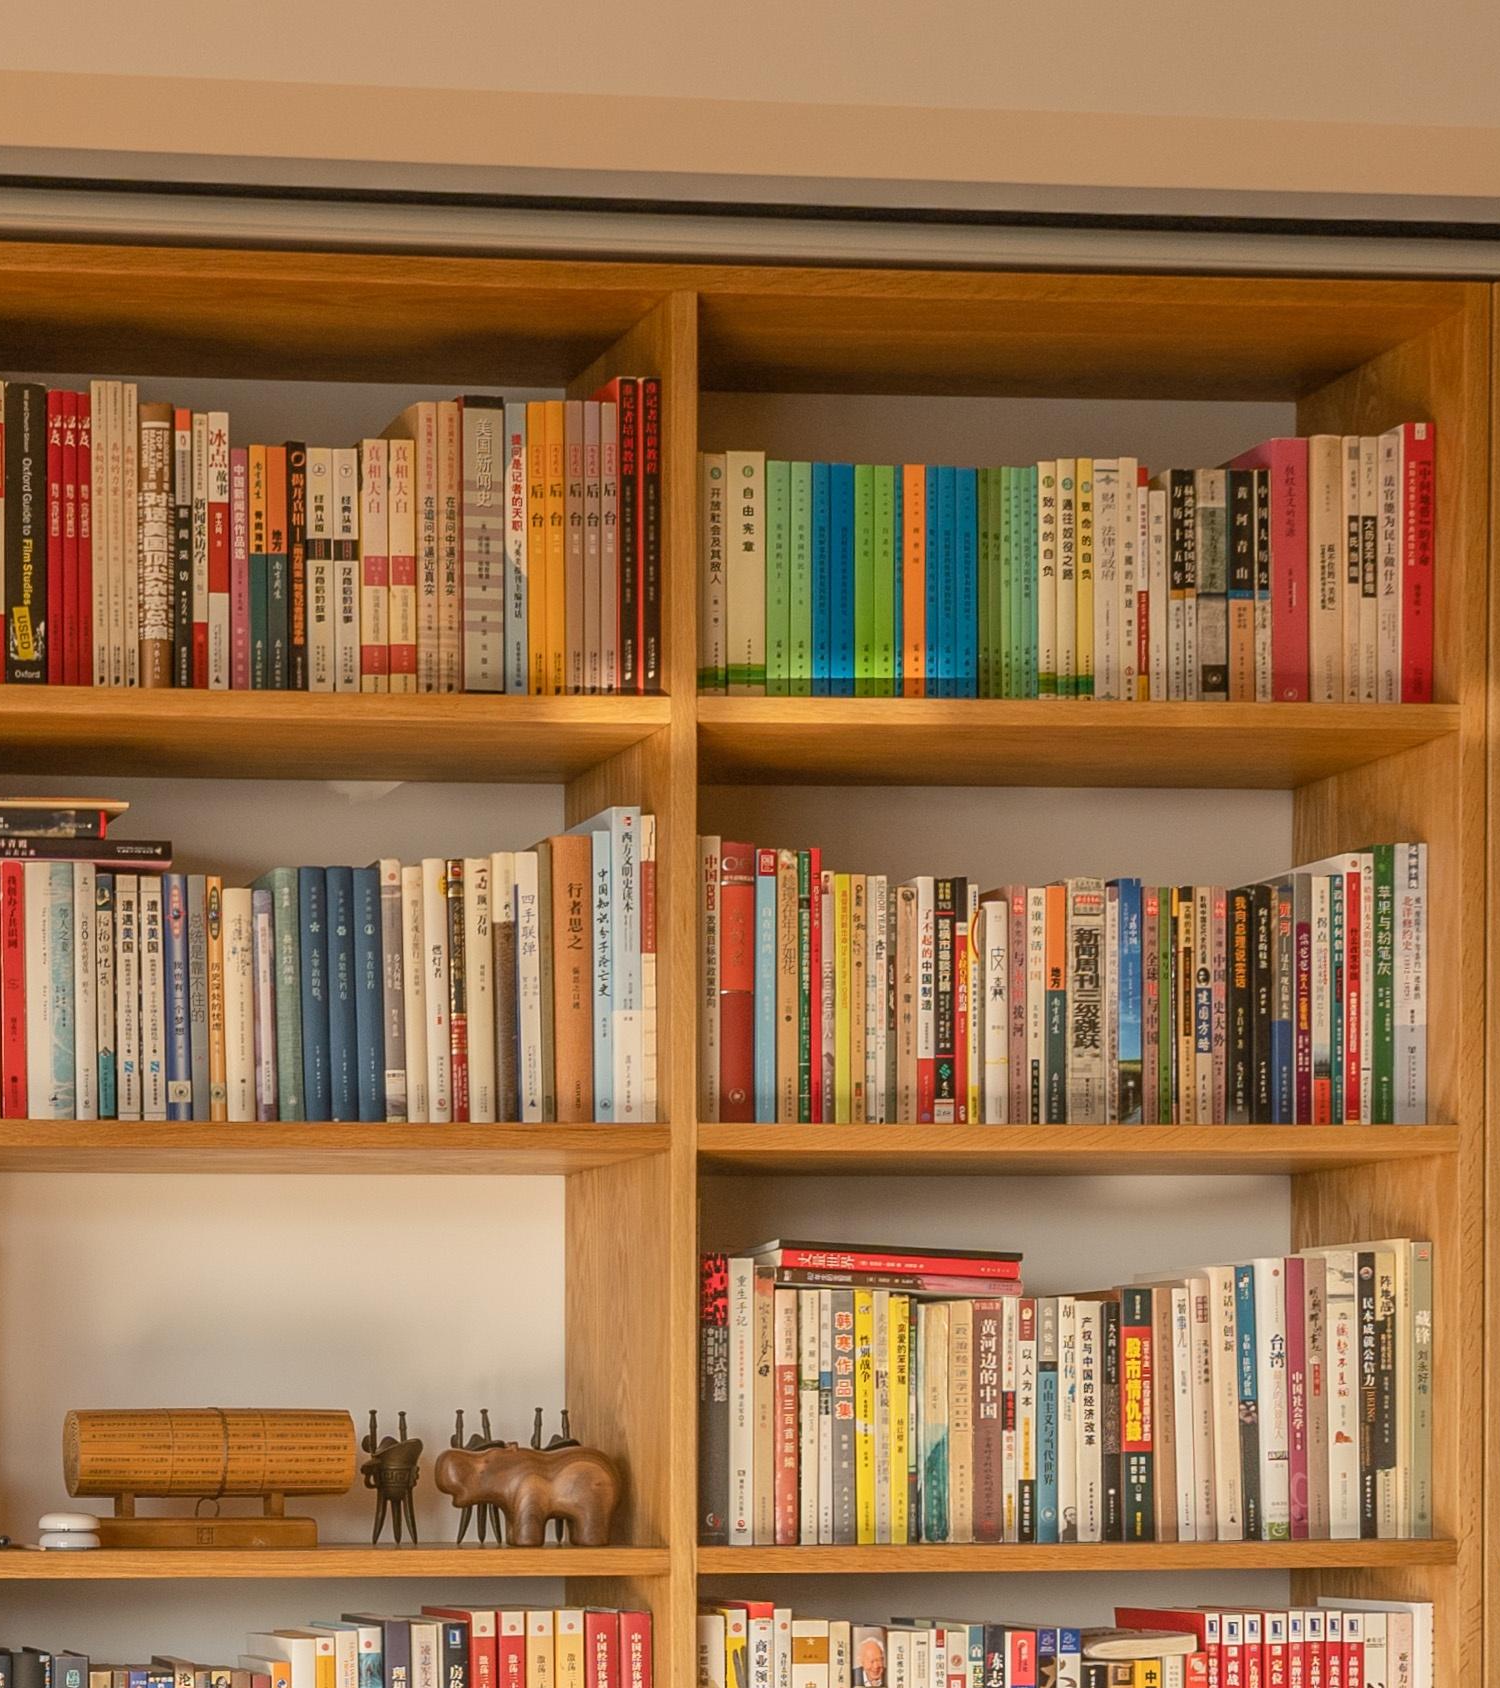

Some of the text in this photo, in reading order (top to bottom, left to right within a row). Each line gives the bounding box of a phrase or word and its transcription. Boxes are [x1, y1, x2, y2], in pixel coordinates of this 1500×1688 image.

[22, 457, 32, 492] Oxford
[22, 494, 32, 524] Guide
[530, 485, 543, 529] 后台
[23, 539, 33, 563] Film
[23, 564, 32, 606] Studies
[17, 615, 31, 651] USED
[15, 669, 41, 679] Oxford
[835, 1313, 854, 1419] 韩寒作品集
[980, 1319, 999, 1420] 黄河边的中国
[1082, 1317, 1096, 1448] 产权与中国的经济改革
